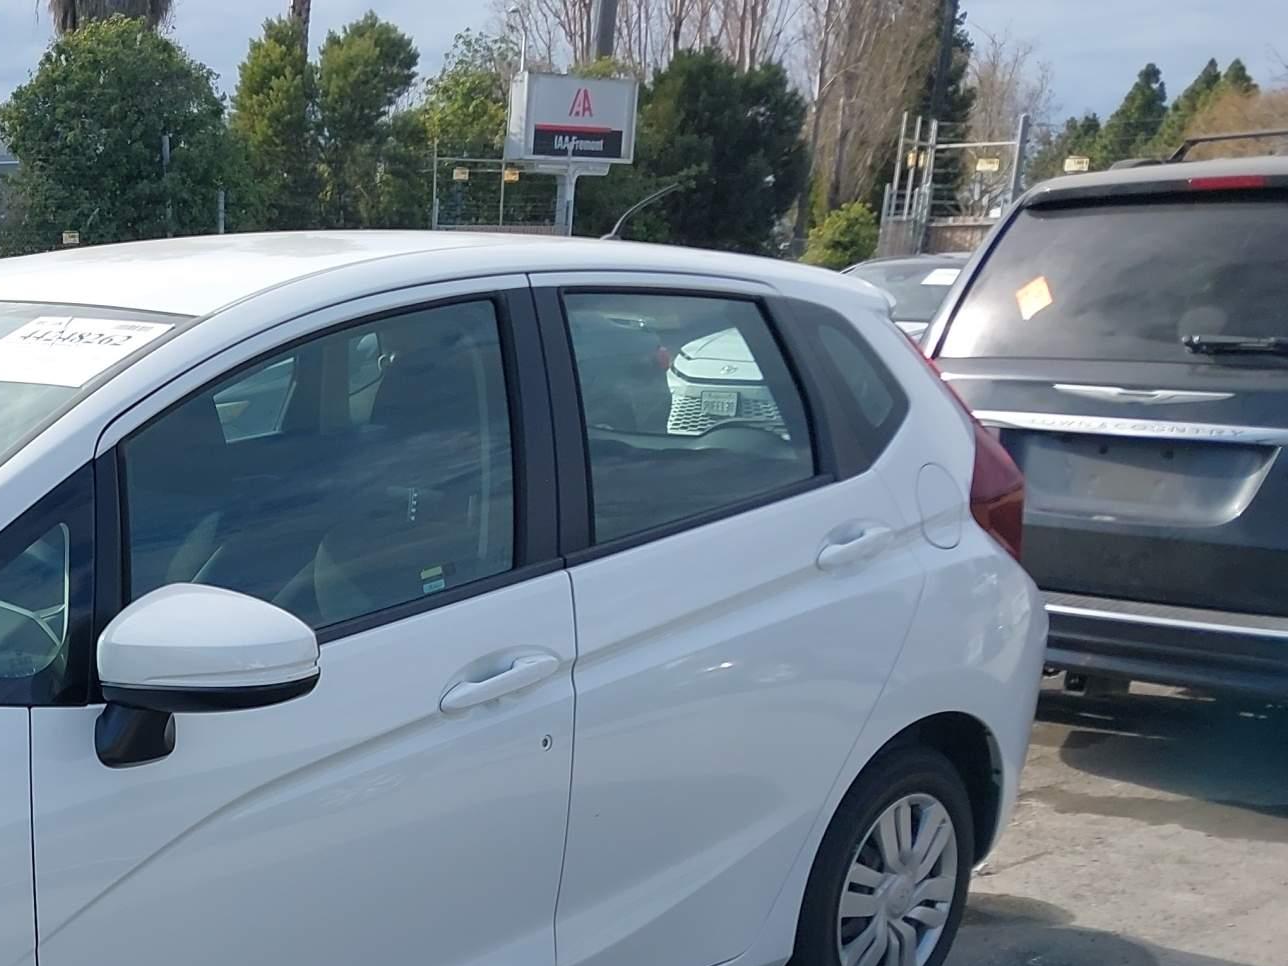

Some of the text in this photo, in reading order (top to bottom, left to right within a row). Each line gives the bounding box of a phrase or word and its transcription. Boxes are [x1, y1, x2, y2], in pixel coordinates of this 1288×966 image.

[554, 135, 604, 151] IAA Fremont
[20, 330, 133, 347] 44248262
